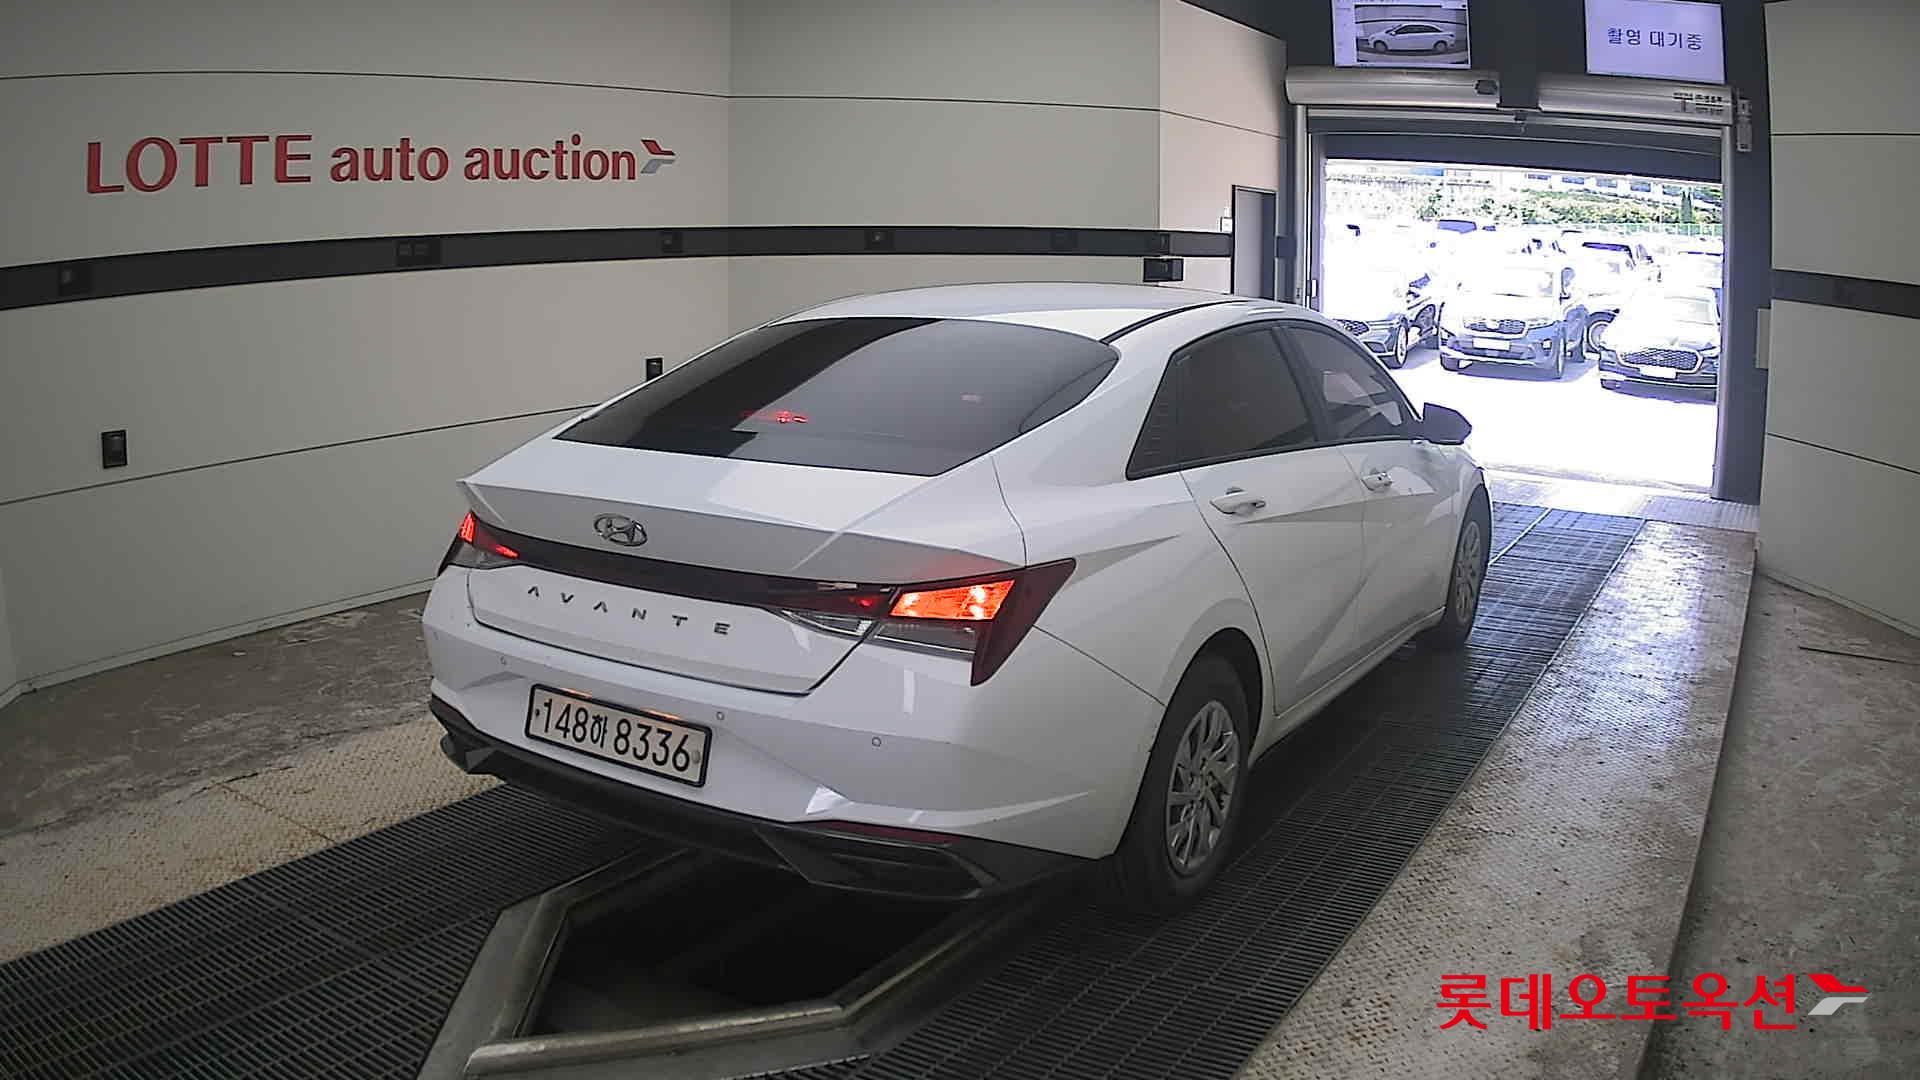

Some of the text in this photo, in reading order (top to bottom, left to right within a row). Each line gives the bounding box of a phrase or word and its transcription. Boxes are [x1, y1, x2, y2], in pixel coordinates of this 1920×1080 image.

[1608, 28, 1641, 46] 촬영
[87, 134, 637, 194] LOTTE auto auction
[527, 585, 731, 636] AVANTE
